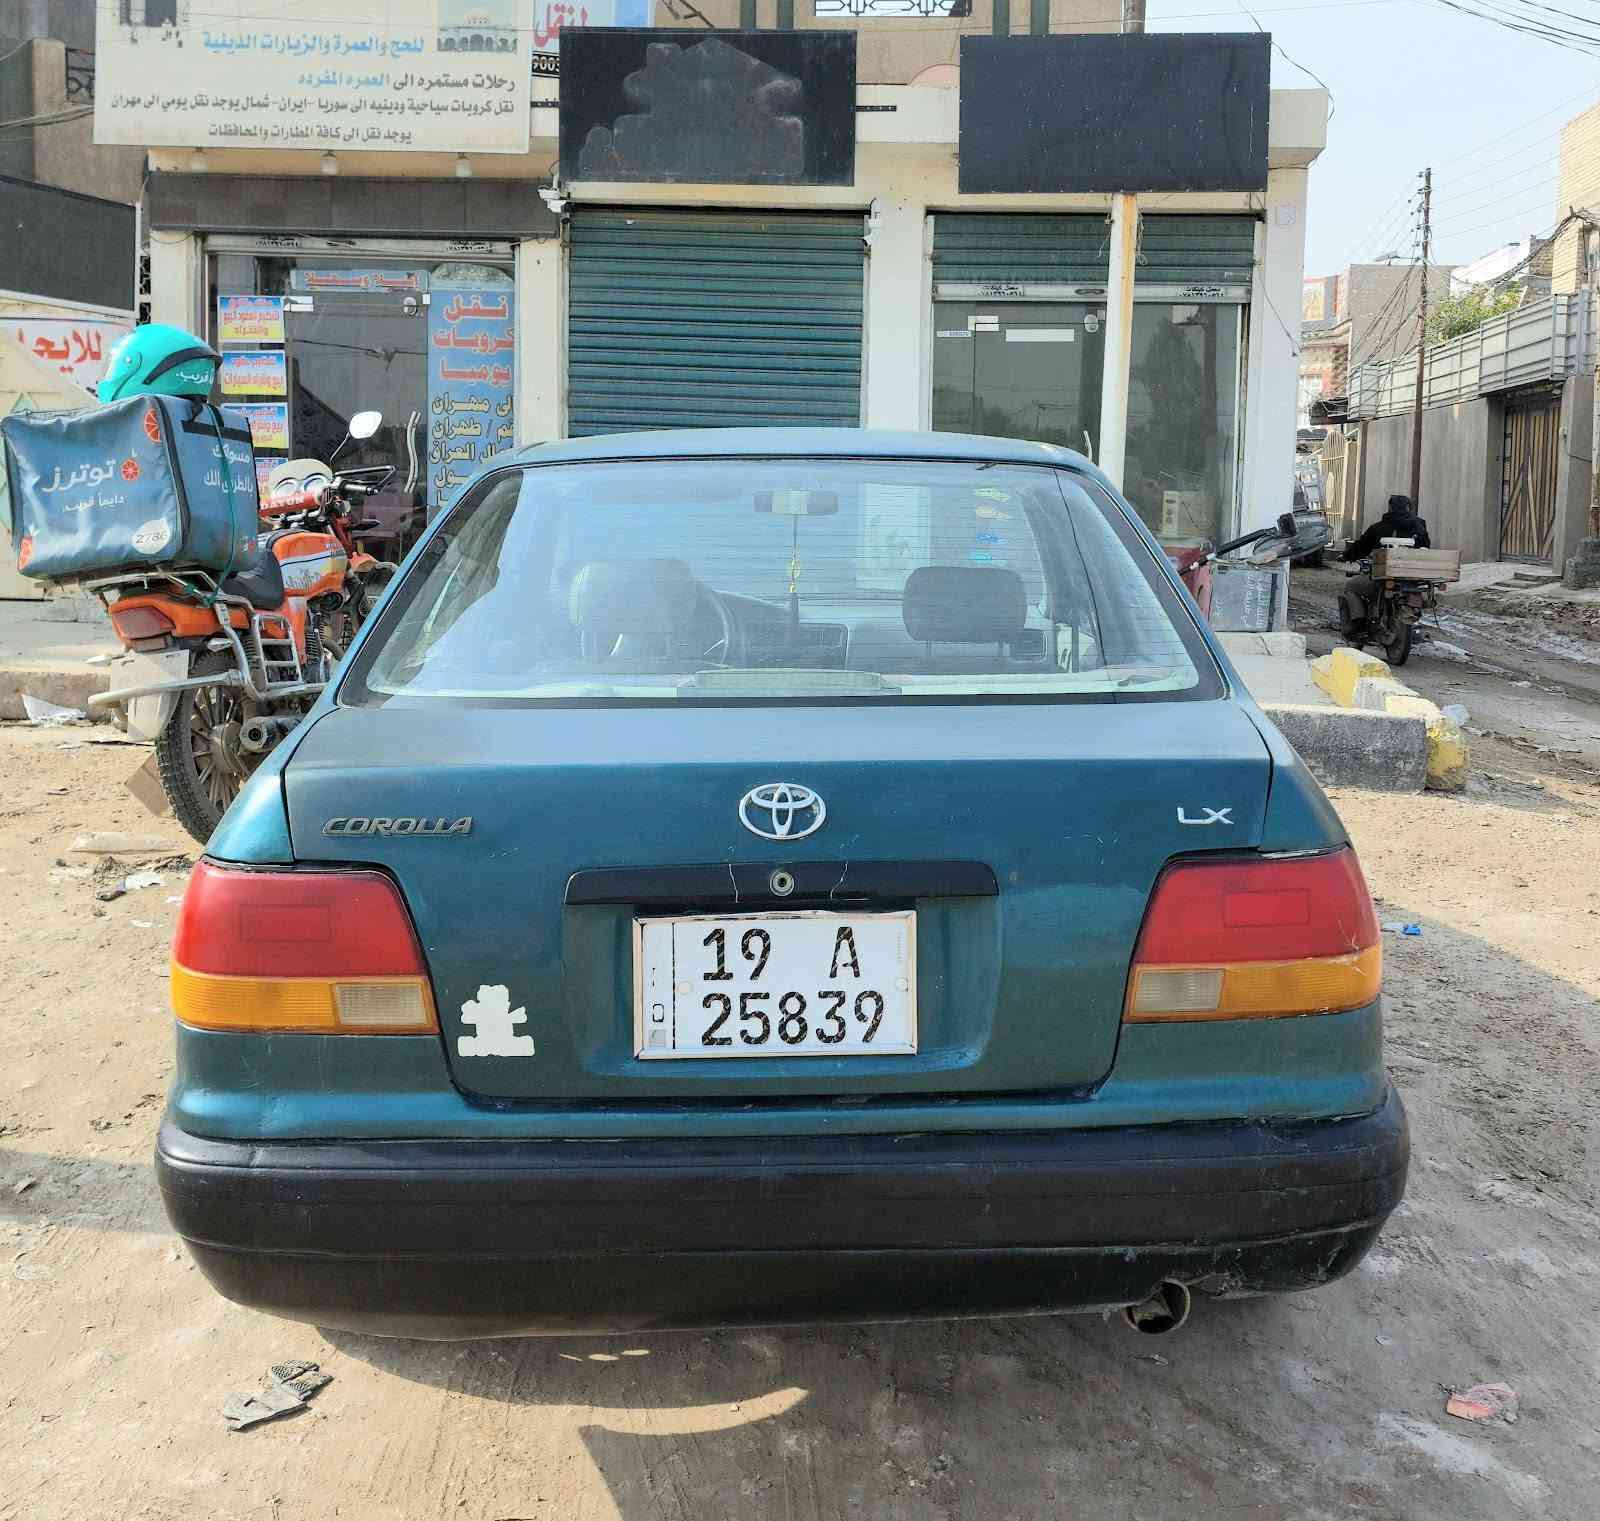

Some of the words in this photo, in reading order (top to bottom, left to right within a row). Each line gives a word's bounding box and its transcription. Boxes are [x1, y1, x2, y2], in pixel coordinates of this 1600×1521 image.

[202, 31, 256, 54] الدينية
[261, 33, 330, 56] والزيارات
[333, 36, 386, 56] والعمرة
[391, 36, 424, 58] للحج
[345, 72, 390, 89] العمره
[393, 73, 414, 89] الى
[418, 74, 467, 90] مستمره
[472, 73, 515, 91] رحلات
[111, 95, 141, 108] مهران
[190, 94, 209, 110] نقل
[211, 96, 240, 111] يوجد
[318, 98, 348, 113] سوريا
[350, 98, 367, 112] الى
[407, 99, 448, 115] سياحية
[451, 100, 492, 115] كروبات
[495, 100, 514, 115] نقل
[208, 124, 268, 141] والمحافظات
[271, 125, 313, 140] المطارات
[317, 126, 341, 139] كافة
[343, 127, 359, 141] الى
[363, 128, 381, 142] نقل
[383, 128, 412, 144] يوجد
[443, 294, 509, 322] نقل
[440, 359, 513, 387] يوميا
[431, 392, 490, 416] مهران
[431, 417, 482, 442] طهران
[429, 440, 476, 464] العراق
[42, 459, 116, 493] توترز
[1177, 806, 1235, 826] LX
[321, 815, 474, 837] COROLLA
[702, 927, 772, 982] 19
[829, 926, 861, 979] A
[701, 990, 885, 1046] 25839
